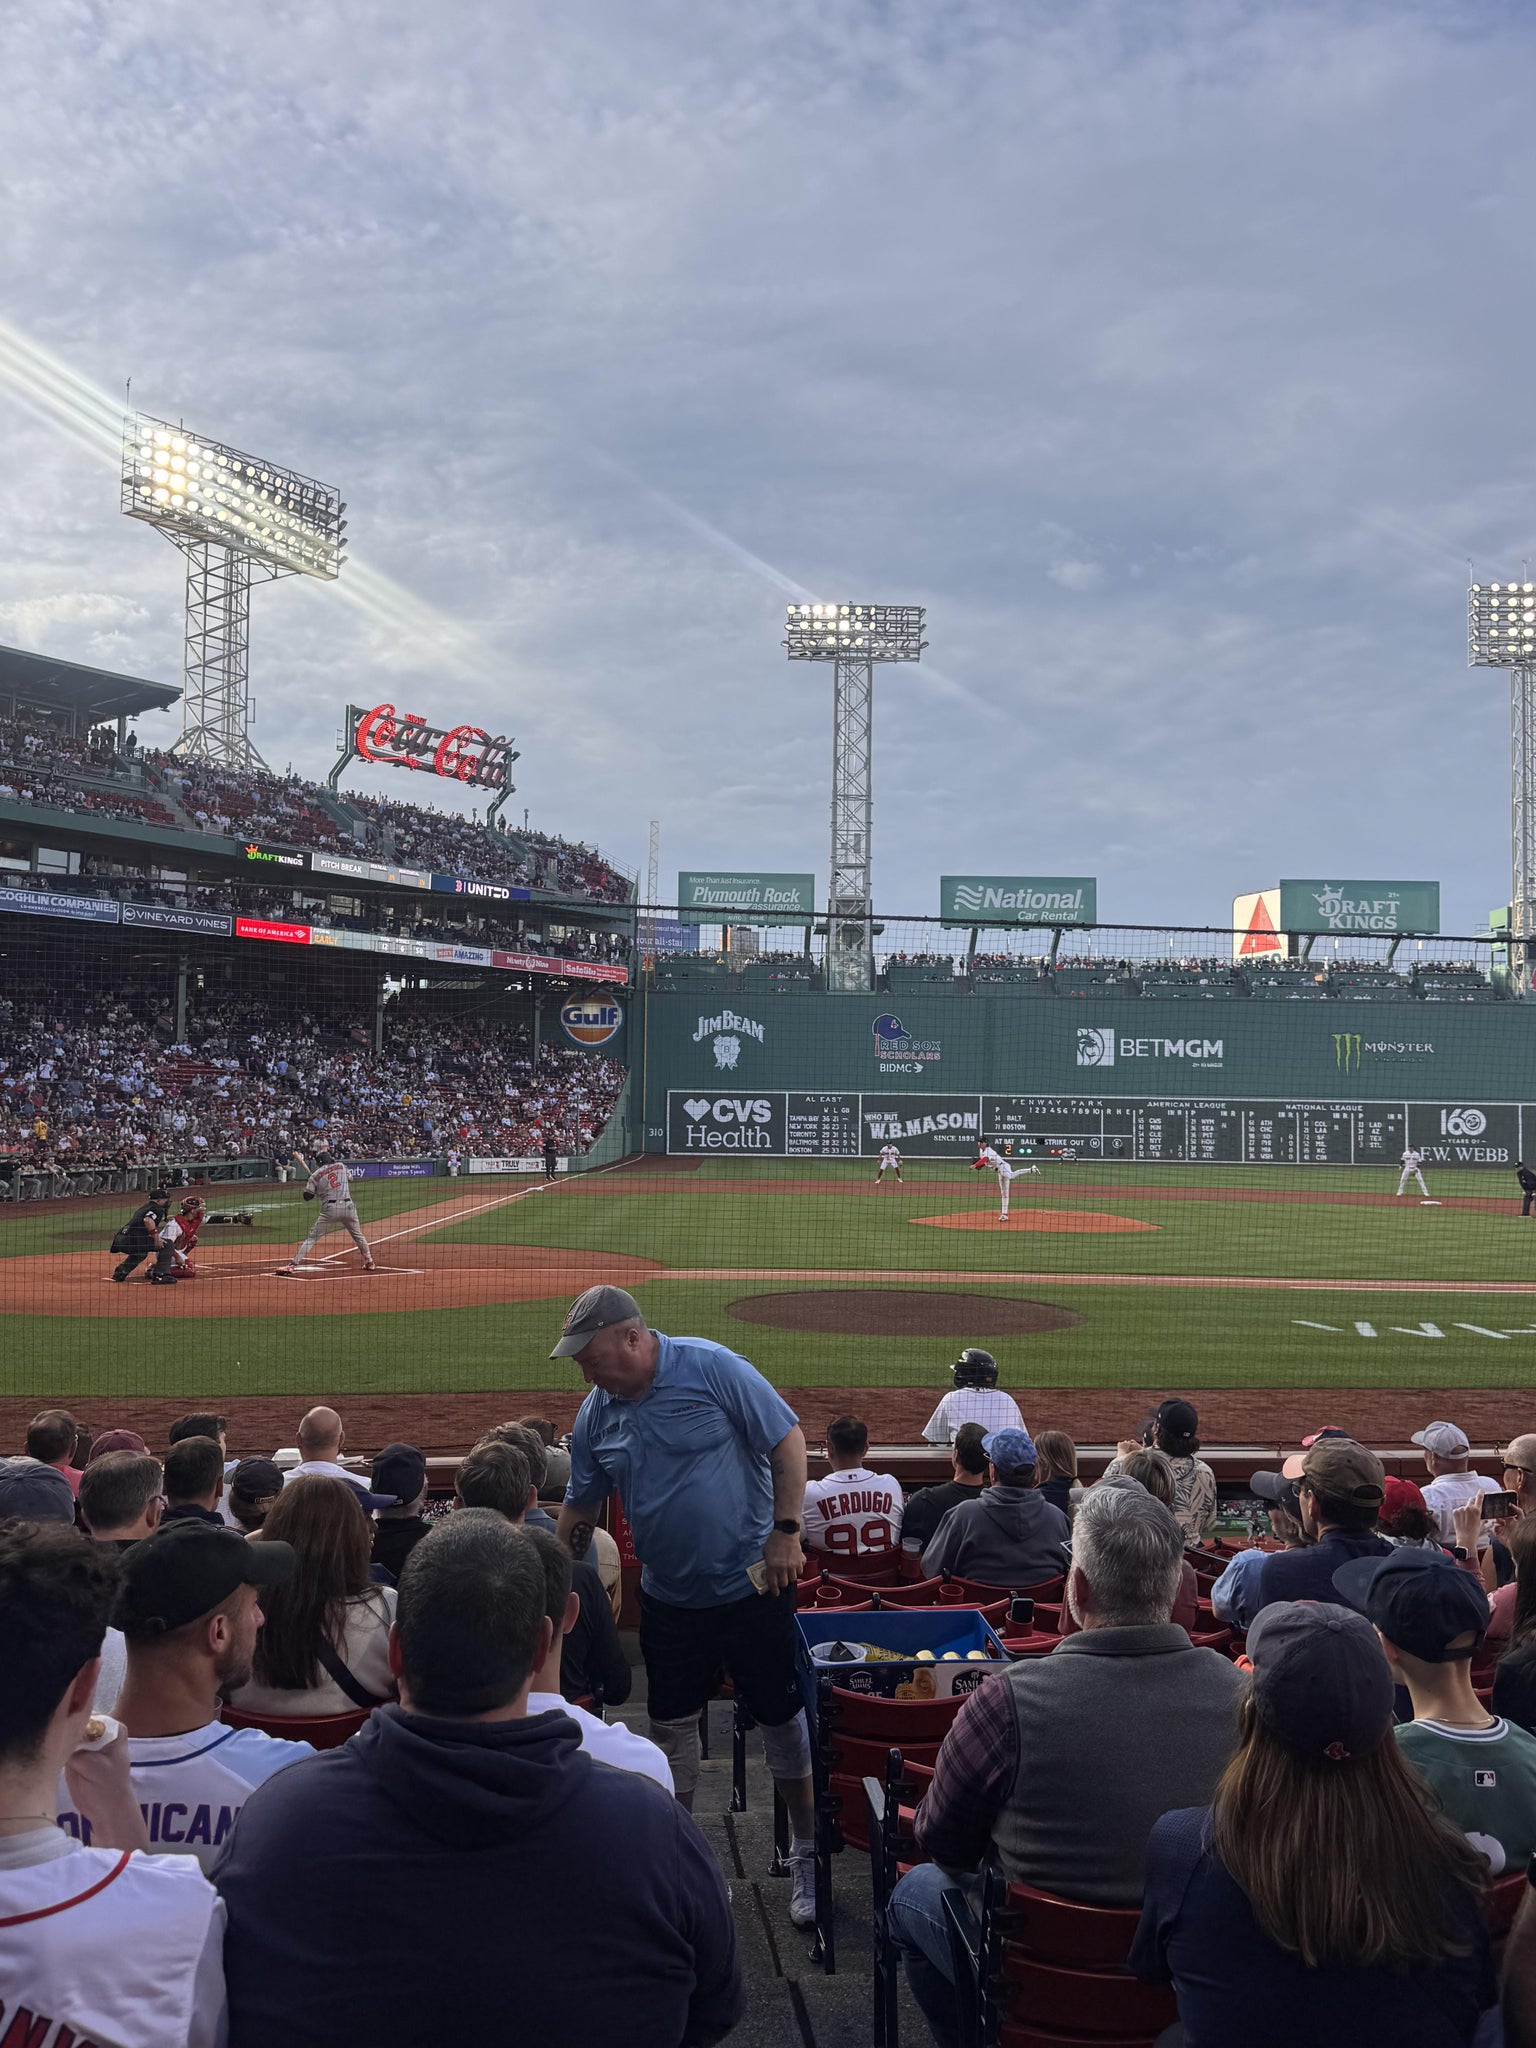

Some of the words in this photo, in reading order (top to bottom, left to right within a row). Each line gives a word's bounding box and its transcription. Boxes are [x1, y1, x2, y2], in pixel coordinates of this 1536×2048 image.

[320, 859, 340, 870] PITCH
[341, 862, 363, 874] BREAK
[705, 876, 720, 884] Than
[467, 882, 509, 899] UNITED
[693, 886, 761, 904] Plymouth
[763, 887, 800, 903] Rock
[0, 890, 50, 906] COGHLIN
[50, 896, 118, 914] COMPANIES
[751, 903, 801, 911] assurance
[1318, 898, 1400, 917] DRAFT
[135, 910, 193, 925] VINEYARD
[195, 917, 230, 930] VINES
[1017, 911, 1038, 921] Car
[1040, 911, 1078, 921] Rental
[1328, 913, 1398, 930] KINGS
[240, 925, 257, 933] BANK
[266, 928, 294, 937] AMERICA
[563, 1006, 618, 1025] Gulf
[692, 1015, 722, 1042] JIM
[722, 1010, 766, 1043] BEAM
[880, 1040, 909, 1051] RED
[912, 1040, 941, 1051] SOX
[1120, 1038, 1223, 1058] BETMGM
[880, 1050, 941, 1060] SCHOLARS
[879, 1063, 912, 1073] BIDMC
[1012, 1098, 1062, 1106] FENWAY
[712, 1098, 772, 1123] CVS
[863, 1113, 883, 1121] WHO
[883, 1113, 899, 1121] BUT
[1034, 1106, 1040, 1114] 2
[1041, 1106, 1047, 1114] 3
[1084, 1107, 1090, 1115] 9
[1002, 1123, 1026, 1131] BOSTON
[1440, 1108, 1487, 1136] 160
[648, 1127, 664, 1137] 310
[685, 1124, 773, 1148] Health
[1005, 1144, 1012, 1155] 2
[1420, 1146, 1451, 1161] F.W.
[1454, 1147, 1509, 1162] WEBB
[501, 1160, 520, 1168] TRULY
[327, 1172, 341, 1189] 2
[816, 1490, 893, 1521] VERDUGO
[824, 1520, 892, 1556] 99
